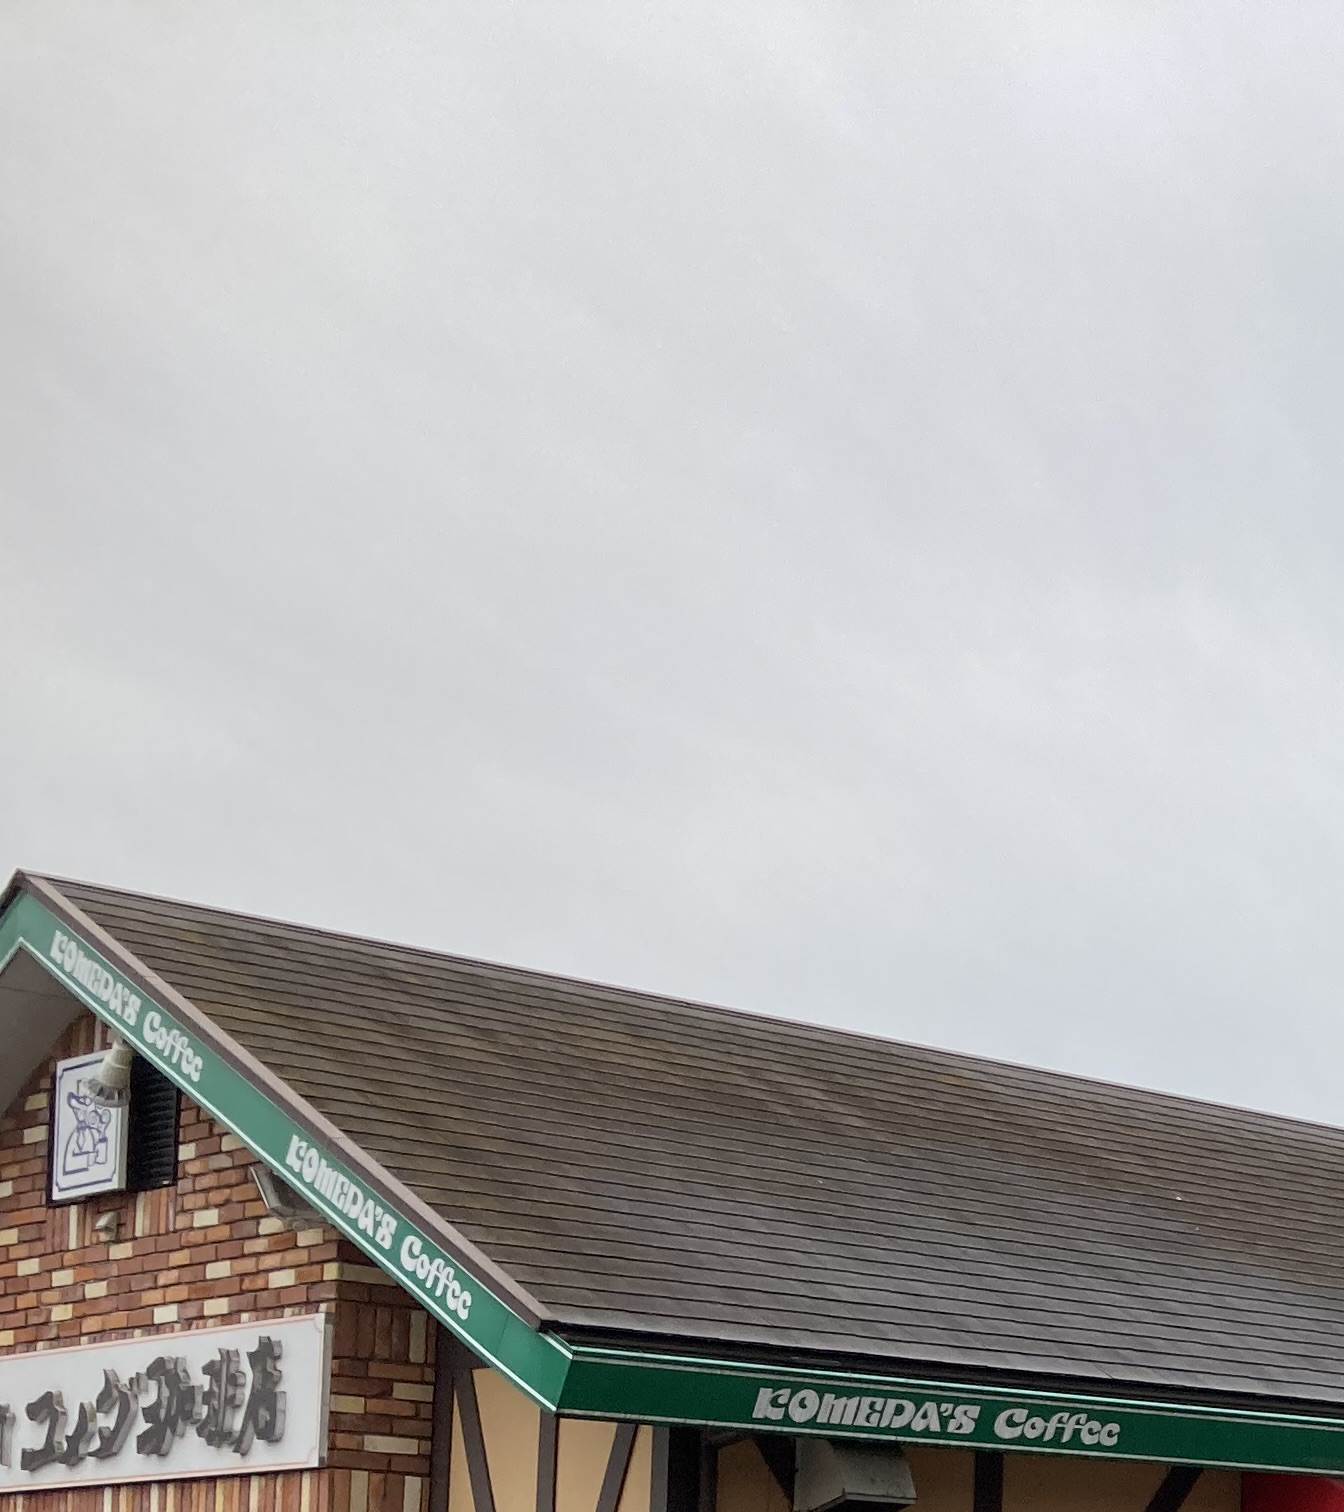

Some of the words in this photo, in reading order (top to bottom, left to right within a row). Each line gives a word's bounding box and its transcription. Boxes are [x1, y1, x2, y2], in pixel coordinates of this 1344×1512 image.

[50, 929, 141, 1026] KOMEDA'S
[144, 1011, 203, 1081] Coffee
[286, 1134, 397, 1250] KOMEDA'S
[400, 1235, 472, 1320] Coffee
[752, 1387, 981, 1434] KOMEDA'S
[993, 1408, 1120, 1447] Coffee
